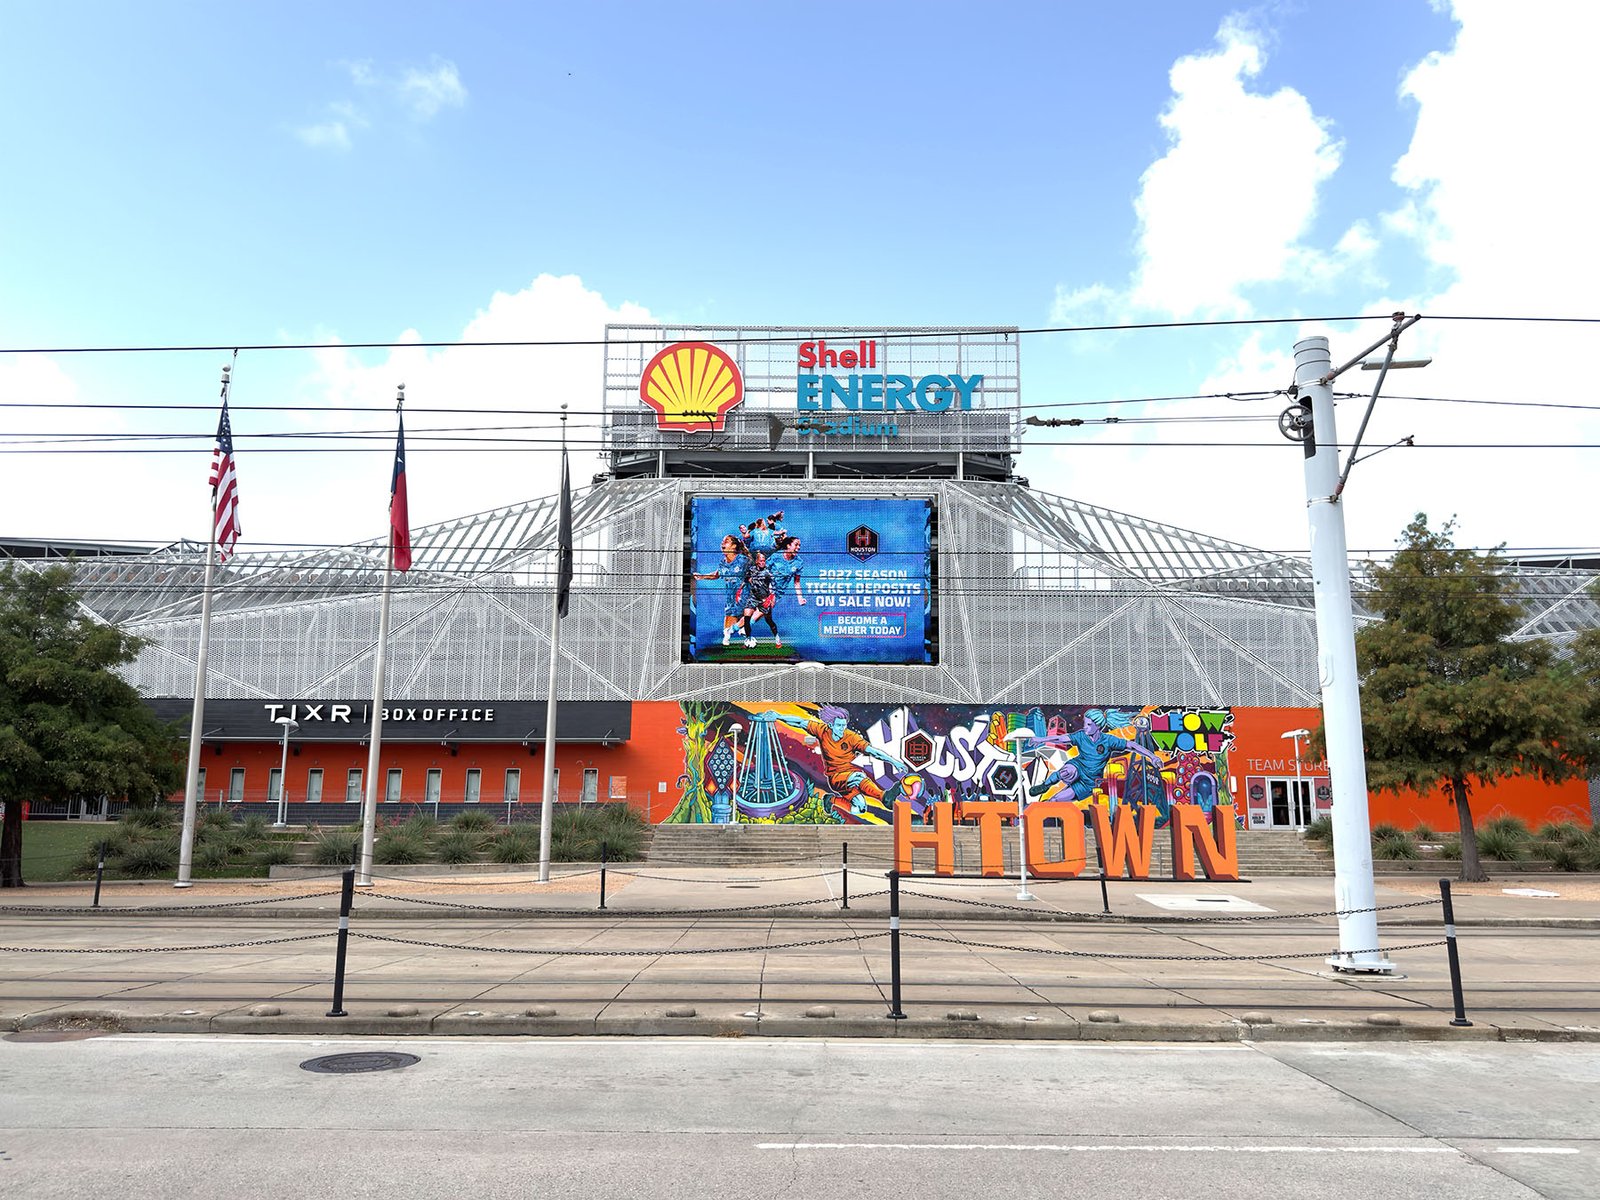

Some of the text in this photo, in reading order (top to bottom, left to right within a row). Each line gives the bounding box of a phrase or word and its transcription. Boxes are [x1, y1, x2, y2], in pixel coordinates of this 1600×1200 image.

[799, 340, 876, 369] Shell
[798, 374, 985, 412] ENERGY
[819, 569, 908, 581] 2027 SEASON
[805, 582, 921, 595] TICKET DEPOSITS
[815, 595, 911, 608] ON SALE NOW!
[838, 616, 888, 625] BECOME A
[823, 625, 902, 635] MEMBER TODAY
[264, 704, 495, 723] TIXR BOX OFFICE
[1150, 712, 1227, 731] MEOW
[1151, 731, 1224, 752] WOLF
[1247, 758, 1285, 771] TEAM
[894, 801, 1239, 881] HTOWN
